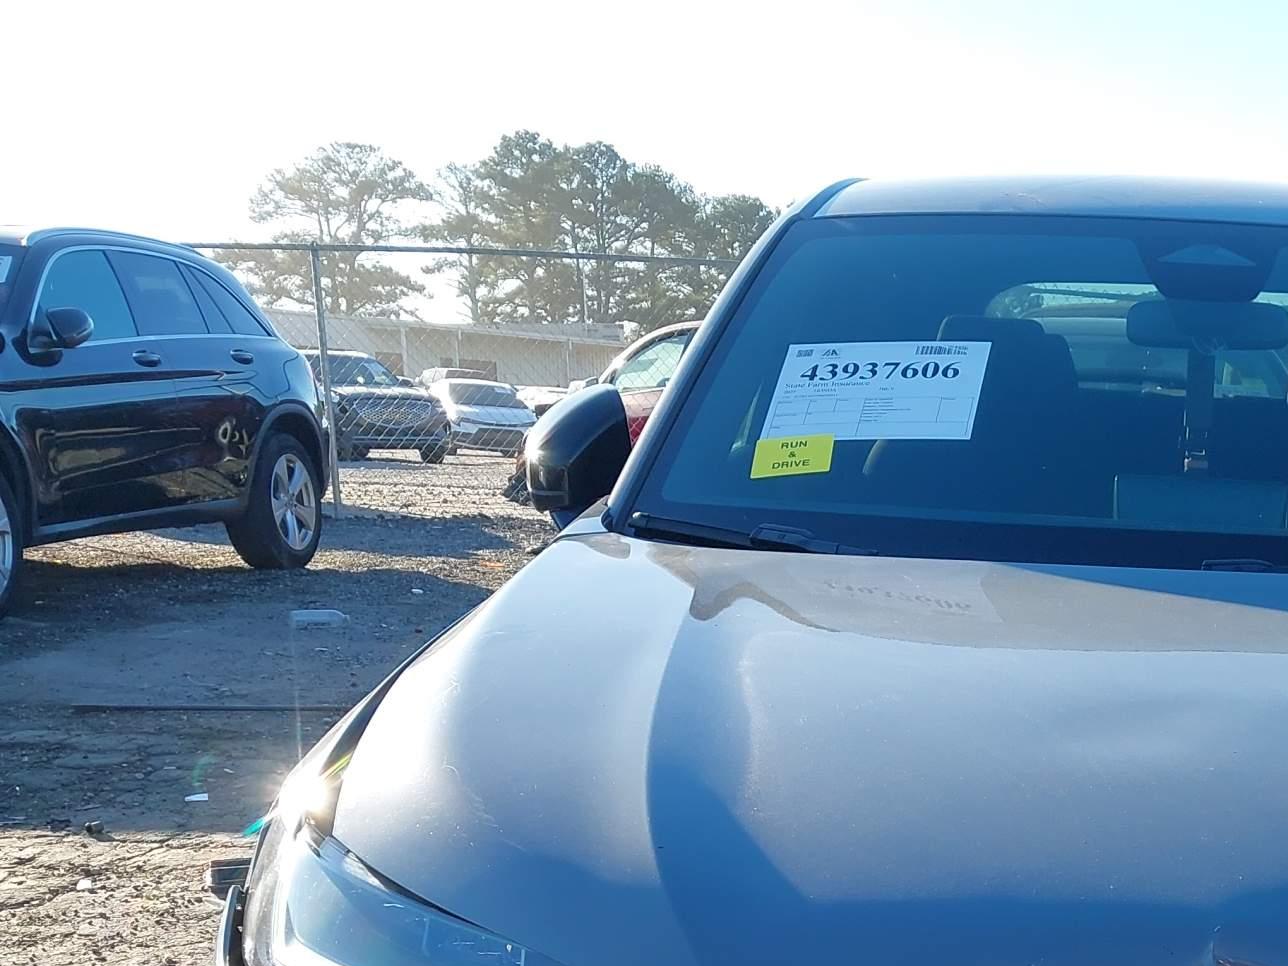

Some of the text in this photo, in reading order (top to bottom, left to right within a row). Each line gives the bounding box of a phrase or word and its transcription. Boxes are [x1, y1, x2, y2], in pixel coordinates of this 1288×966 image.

[800, 361, 962, 381] 43937606
[808, 380, 829, 388] Farm
[780, 440, 808, 449] RUN
[788, 450, 797, 458] &
[771, 459, 811, 470] DRIVE
